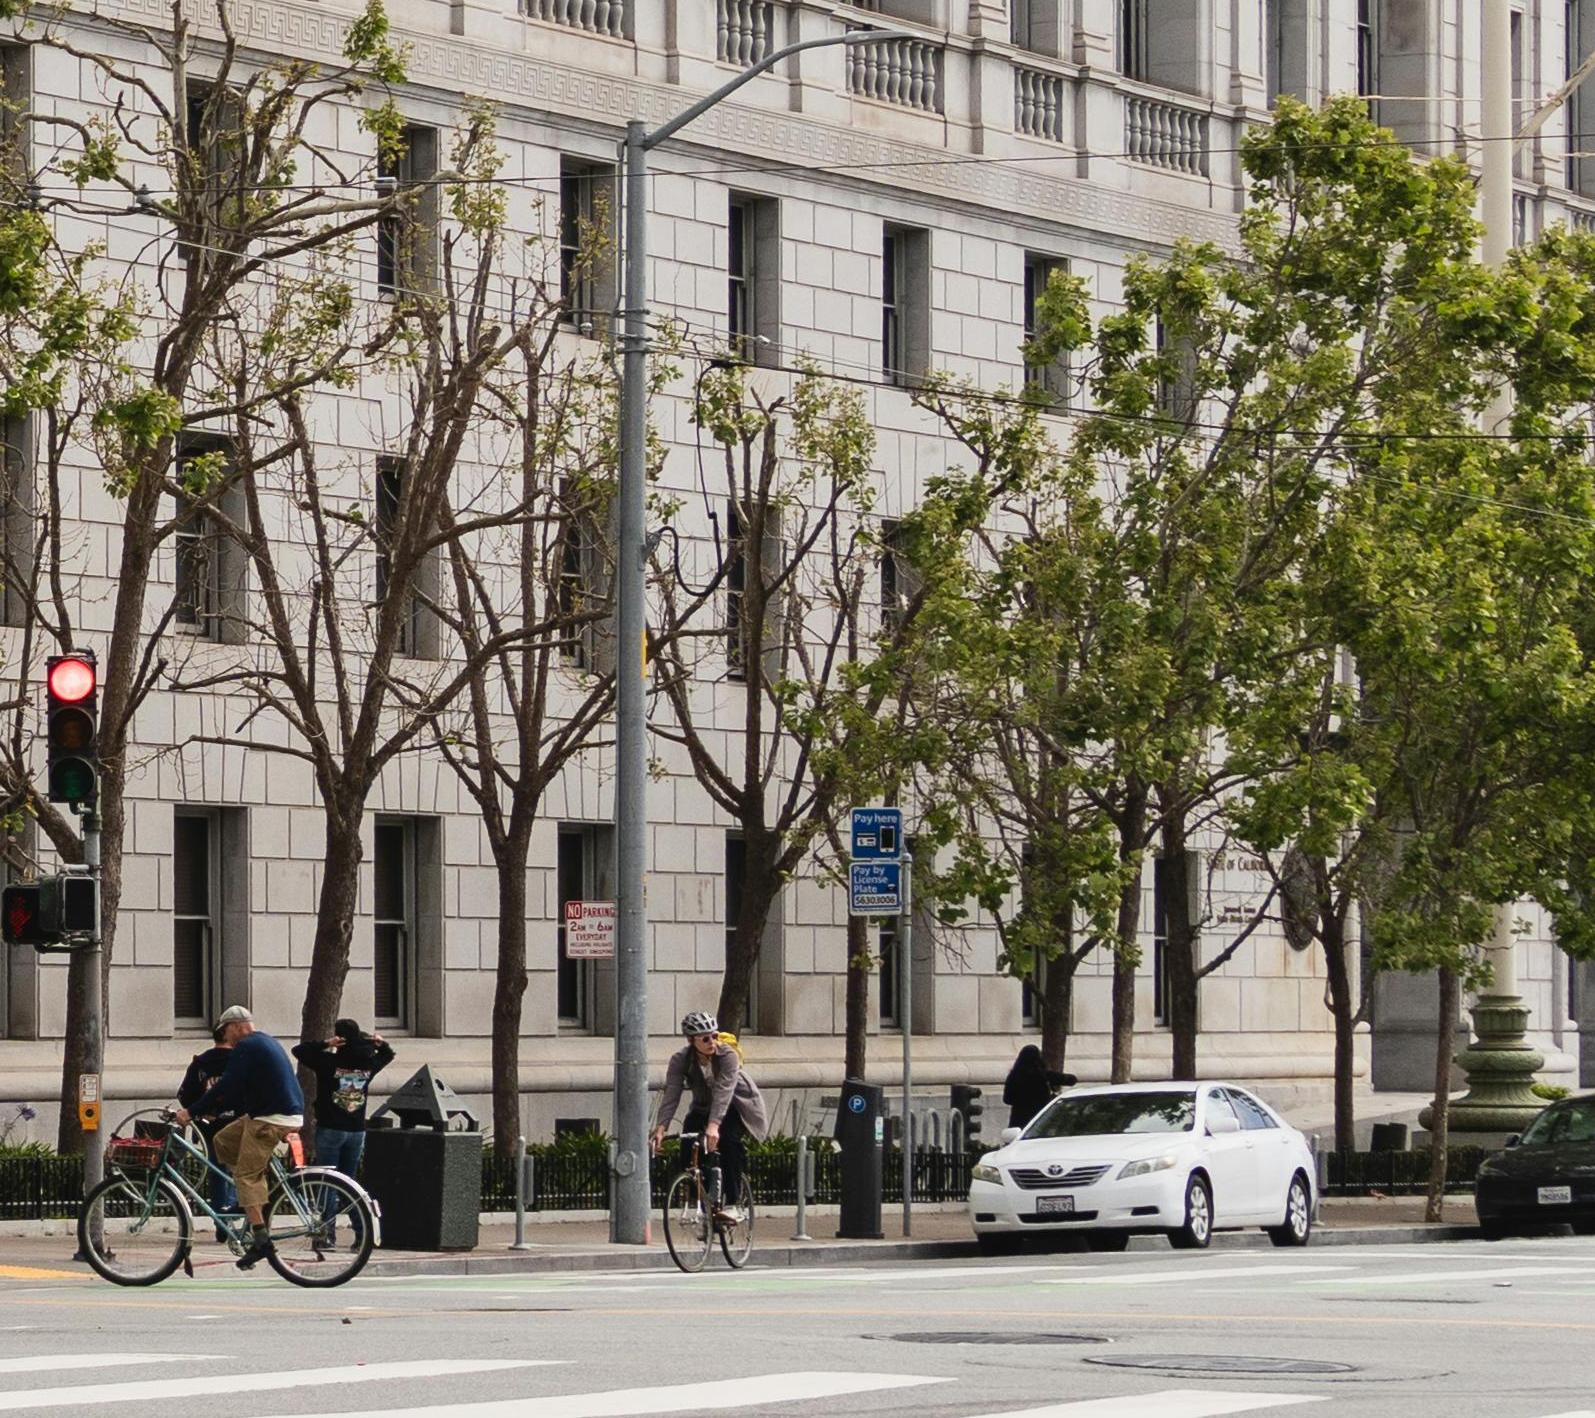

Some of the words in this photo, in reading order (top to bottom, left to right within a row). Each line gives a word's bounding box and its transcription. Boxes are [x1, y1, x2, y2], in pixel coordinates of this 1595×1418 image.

[854, 814, 873, 825] Pay
[874, 813, 898, 823] here
[853, 866, 871, 875] Pay
[873, 866, 885, 875] by
[854, 875, 888, 884] License
[854, 885, 878, 893] Plate
[568, 904, 581, 918] NO
[583, 907, 616, 917] PARKING
